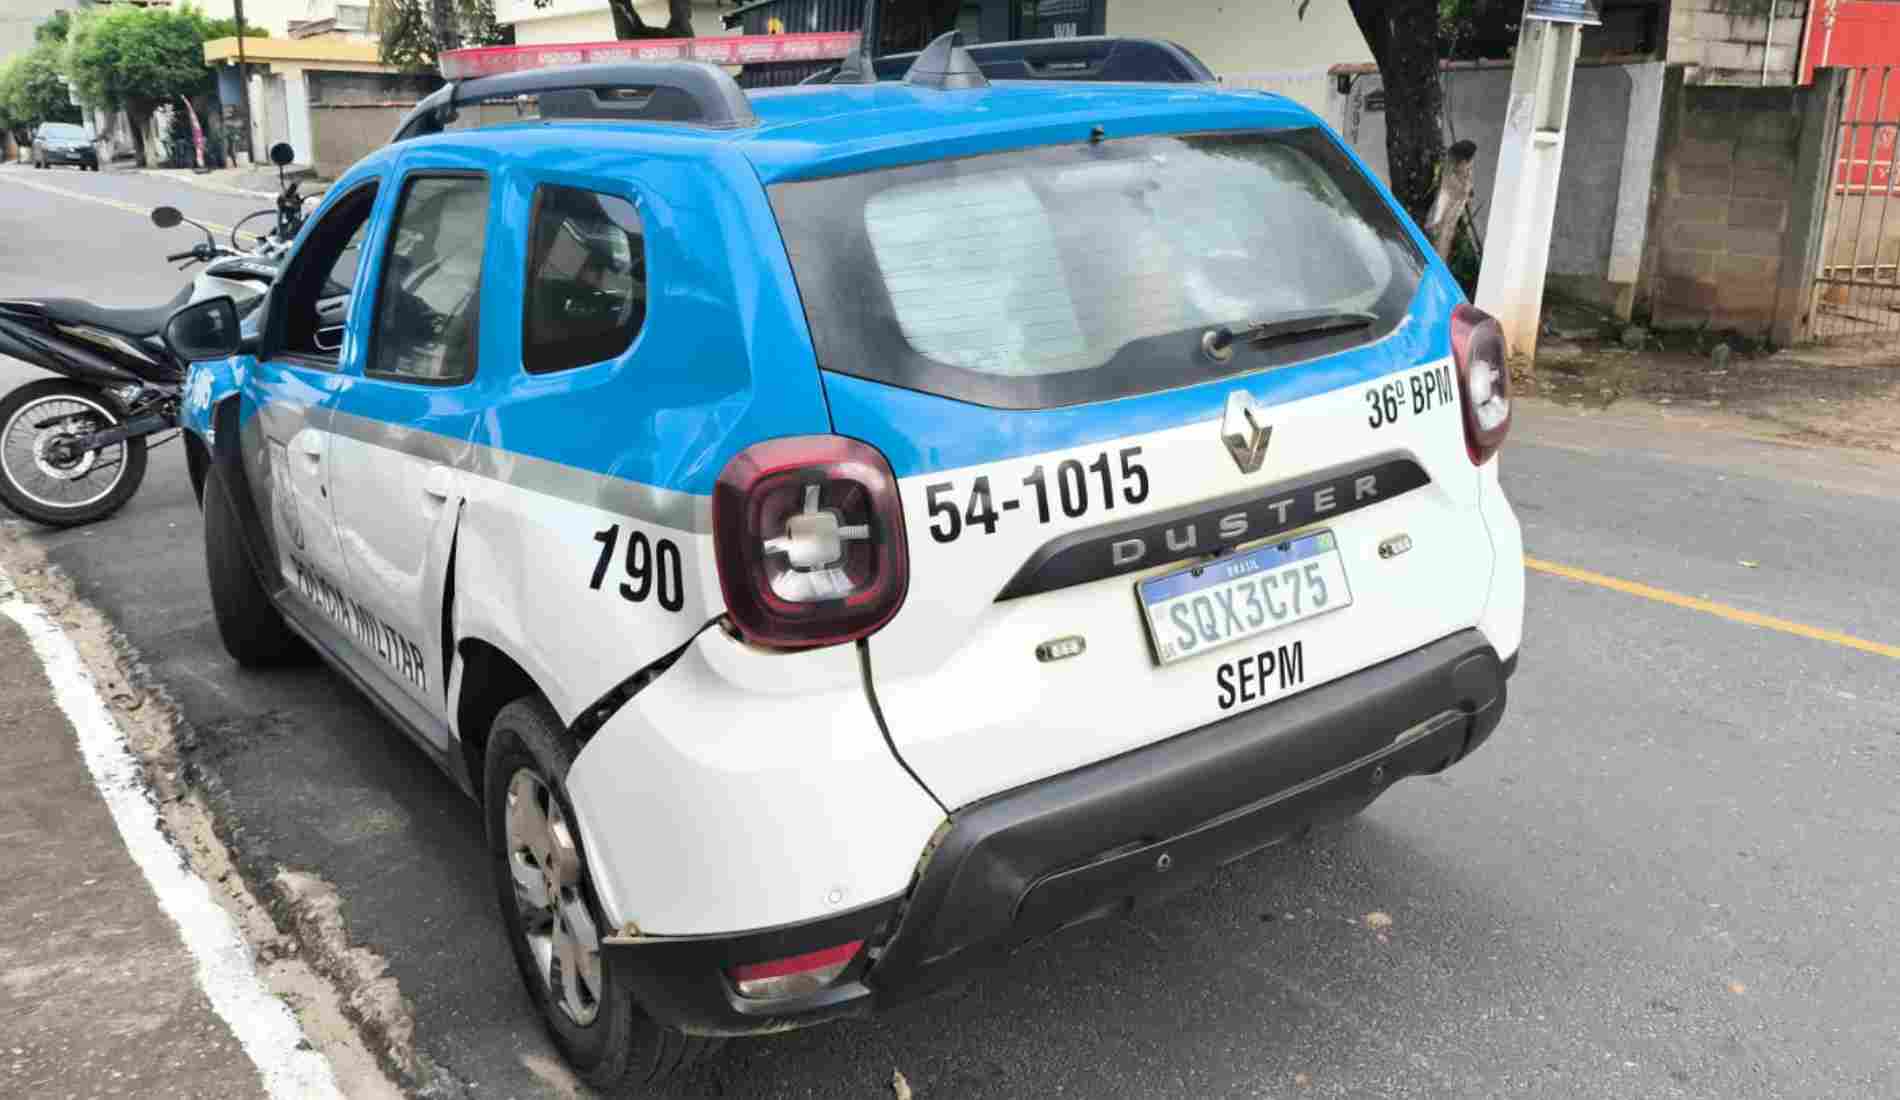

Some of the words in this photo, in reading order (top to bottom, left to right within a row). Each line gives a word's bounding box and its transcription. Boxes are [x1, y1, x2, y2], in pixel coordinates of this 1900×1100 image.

[1409, 365, 1454, 415] BPM
[926, 446, 1150, 543] 54-1015
[1112, 475, 1378, 566] DUSTER
[590, 523, 685, 612] 190
[1170, 562, 1328, 650] SQX3C75
[349, 598, 427, 692] MILITAR
[1217, 640, 1305, 711] SEPM
